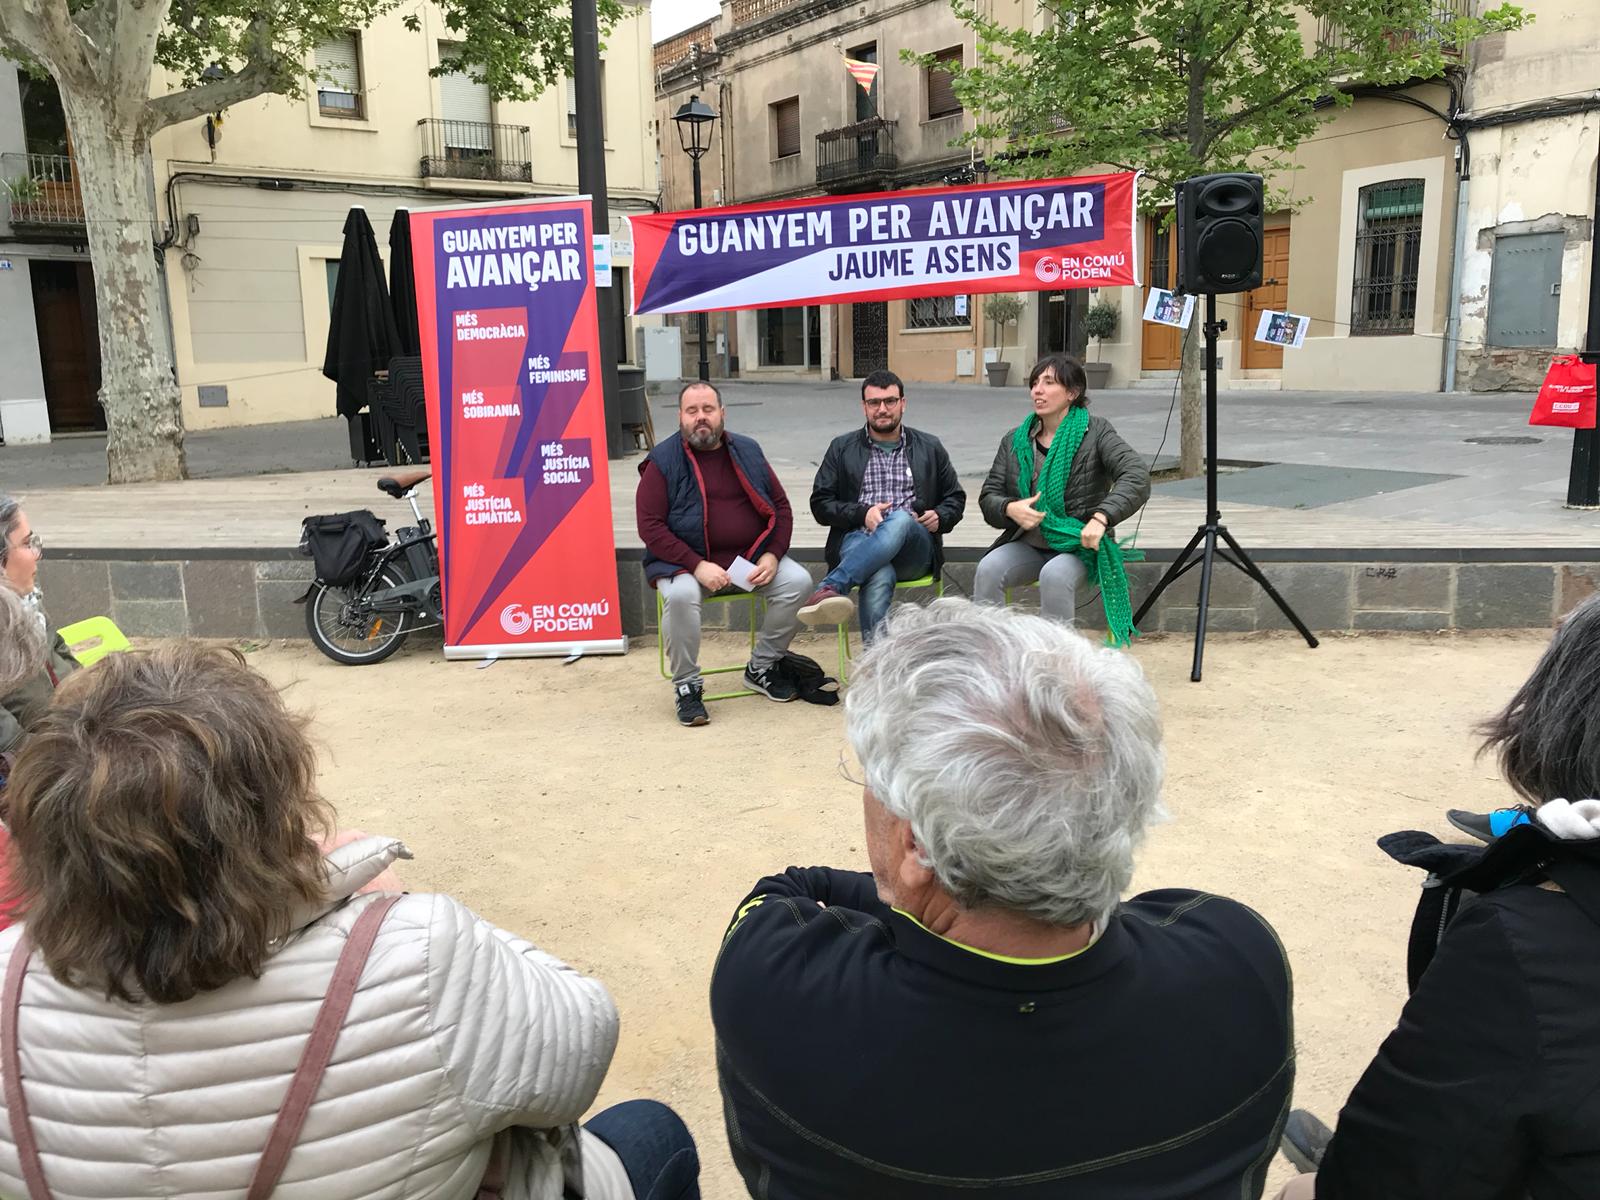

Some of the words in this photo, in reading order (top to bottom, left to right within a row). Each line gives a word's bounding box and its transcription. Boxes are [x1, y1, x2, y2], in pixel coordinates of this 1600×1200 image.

[678, 210, 832, 256] GUANYEM
[849, 203, 911, 244] PER
[928, 191, 1094, 240] AVANÇAR
[442, 225, 537, 253] GUANYEM
[540, 222, 578, 246] PER
[828, 248, 914, 281] JAUME
[925, 242, 1012, 275] ASENS
[1062, 257, 1080, 268] EN
[1083, 251, 1125, 267] COMÚ
[446, 249, 582, 292] AVANÇAR
[1062, 267, 1111, 280] PODEM
[456, 312, 478, 327] MÉS
[457, 323, 526, 341] DEMOCRÀCIA
[528, 355, 550, 370] MÉS
[529, 368, 587, 384] FEMINISME
[462, 390, 484, 405] MÉS
[463, 403, 521, 419] SOBIRANIA
[541, 442, 564, 457] MÉS
[542, 455, 590, 471] JUSTÍCIA
[543, 471, 582, 485] SOCIAL
[463, 483, 485, 498] MÉS
[465, 495, 513, 511] JUSTÍCIA
[532, 604, 555, 618] EN
[558, 598, 610, 617] COMÚ
[533, 616, 593, 632] PODEM
